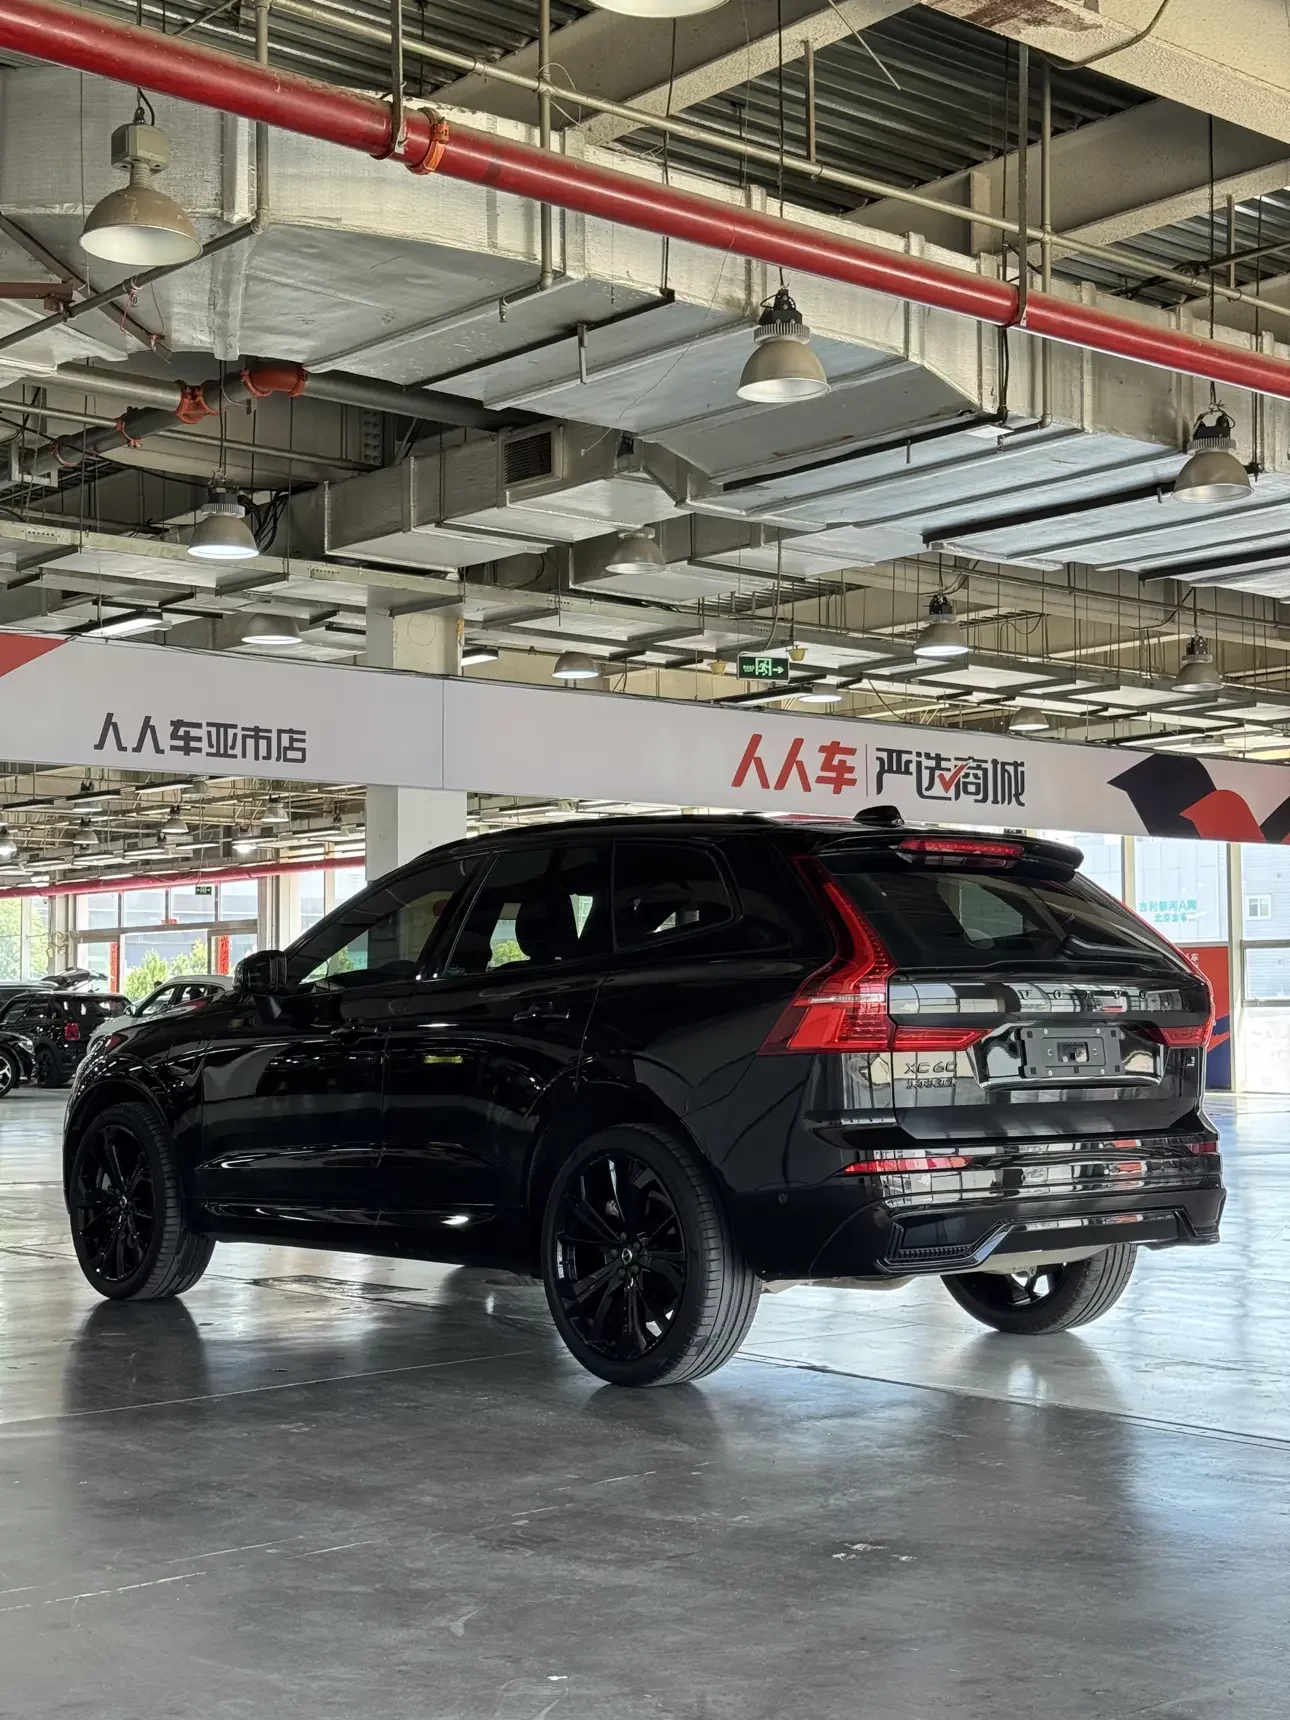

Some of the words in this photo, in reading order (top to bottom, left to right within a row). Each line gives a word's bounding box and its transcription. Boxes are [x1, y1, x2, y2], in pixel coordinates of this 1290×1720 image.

[94, 712, 307, 763] 人人车亚市店
[731, 733, 857, 794] 人人车
[875, 747, 1025, 807] 严选商城
